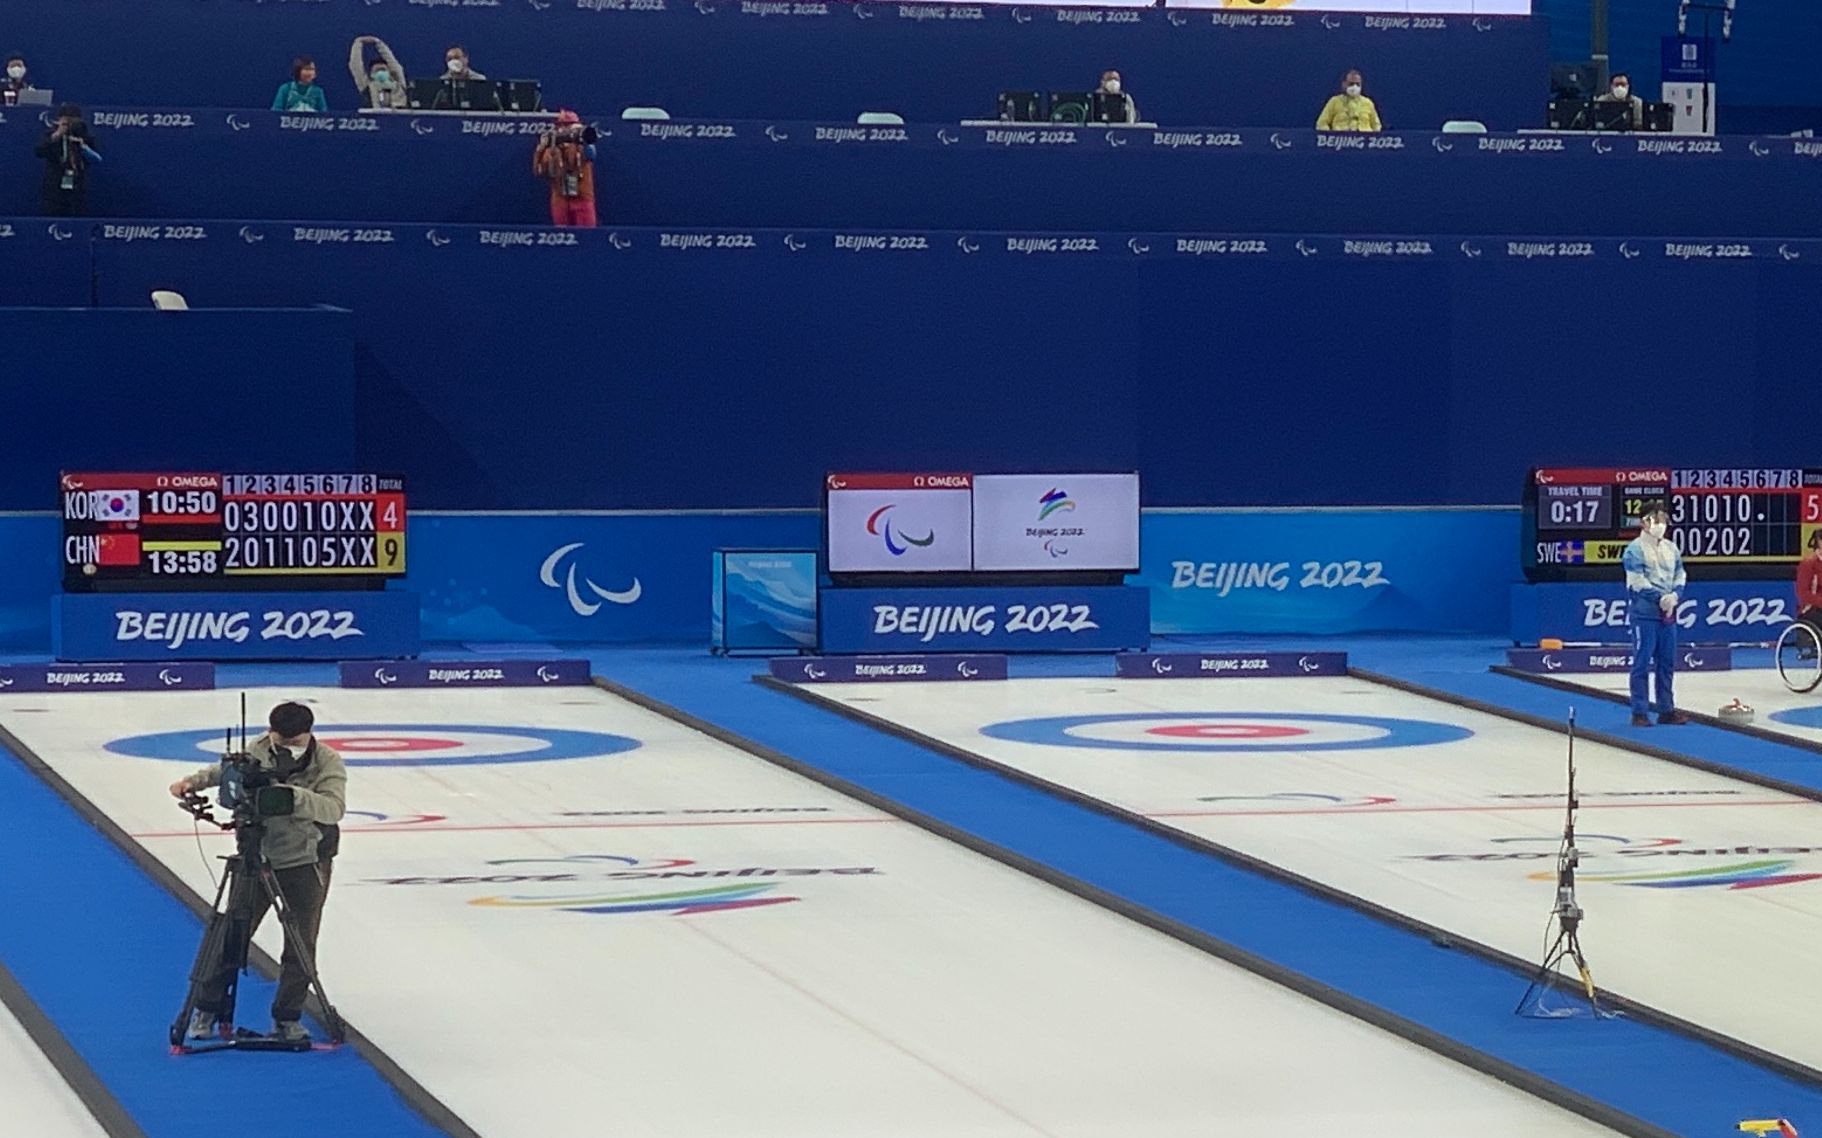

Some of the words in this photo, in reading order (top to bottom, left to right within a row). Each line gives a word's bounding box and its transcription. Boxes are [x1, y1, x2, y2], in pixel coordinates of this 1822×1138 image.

[741, 0, 790, 17] BEIJING
[793, 2, 828, 15] 2022
[898, 5, 946, 20] BEIJING
[949, 7, 983, 19] 2022
[1057, 9, 1103, 25] BEIJING
[1106, 11, 1141, 23] 2022
[1212, 13, 1258, 28] BEIJING
[1260, 14, 1295, 26] 2022
[1365, 15, 1410, 31] BEIJING
[1412, 17, 1447, 29] 2022
[93, 112, 149, 129] BEIJING
[152, 113, 195, 127] 2022
[280, 115, 335, 132] BEIJING
[338, 117, 380, 131] 2022
[462, 120, 515, 137] BEIJING
[640, 123, 693, 140] BEIJING
[696, 125, 737, 138] 2022
[815, 127, 866, 144] BEIJING
[869, 128, 909, 141] 2022
[986, 129, 1036, 146] BEIJING
[1039, 130, 1077, 144] 2022
[1153, 132, 1203, 149] BEIJING
[1205, 133, 1243, 146] 2022
[1317, 134, 1365, 151] BEIJING
[1368, 136, 1405, 149] 2022
[1478, 137, 1526, 154] BEIJING
[1528, 138, 1565, 151] 2022
[1637, 139, 1685, 155] BEIJING
[1687, 140, 1723, 154] 2022
[103, 225, 160, 242] BEIJING
[164, 225, 207, 240] 2022
[293, 227, 350, 245] BEIJING
[353, 229, 395, 242] 2022
[479, 230, 534, 248] BEIJING
[537, 232, 578, 246] 2022
[660, 233, 713, 250] BEIJING
[716, 234, 757, 248] 2022
[835, 235, 887, 252] BEIJING
[889, 236, 929, 249] 2022
[1007, 238, 1058, 255] BEIJING
[1060, 238, 1100, 251] 2022
[1176, 239, 1227, 256] BEIJING
[1229, 240, 1268, 253] 2022
[1344, 240, 1393, 257] BEIJING
[1395, 241, 1432, 254] 2022
[1507, 242, 1556, 259] BEIJING
[1558, 242, 1594, 256] 2022
[1665, 243, 1713, 260] BEIJING
[1715, 244, 1753, 257] 2022
[172, 476, 218, 487] OMEGA
[927, 476, 970, 487] OMEGA
[1628, 471, 1668, 481] OMEGA
[65, 491, 98, 520] KOR
[148, 491, 216, 514] 10:50
[1550, 500, 1599, 523] 0:17
[1806, 494, 1819, 521] 5
[383, 501, 398, 529] 4
[65, 535, 99, 565] CHN
[148, 551, 217, 574] 13:58
[384, 538, 398, 567] 9
[1536, 542, 1562, 563] SWE
[1171, 560, 1290, 598] BEIJING
[1299, 560, 1390, 589] 2022
[1706, 598, 1794, 626] 2022
[115, 611, 250, 650] BEIJING
[260, 609, 364, 640] 2022
[873, 605, 996, 642] BEIJING
[1004, 603, 1099, 633] 2022
[855, 664, 895, 678] BEIJING
[896, 664, 927, 675] 2022
[1200, 659, 1239, 673] BEIJING
[1240, 658, 1269, 670] 2022
[46, 672, 90, 686] BEIJING
[92, 672, 126, 683] 2022
[428, 669, 471, 683] BEIJING
[472, 668, 505, 680] 2022
